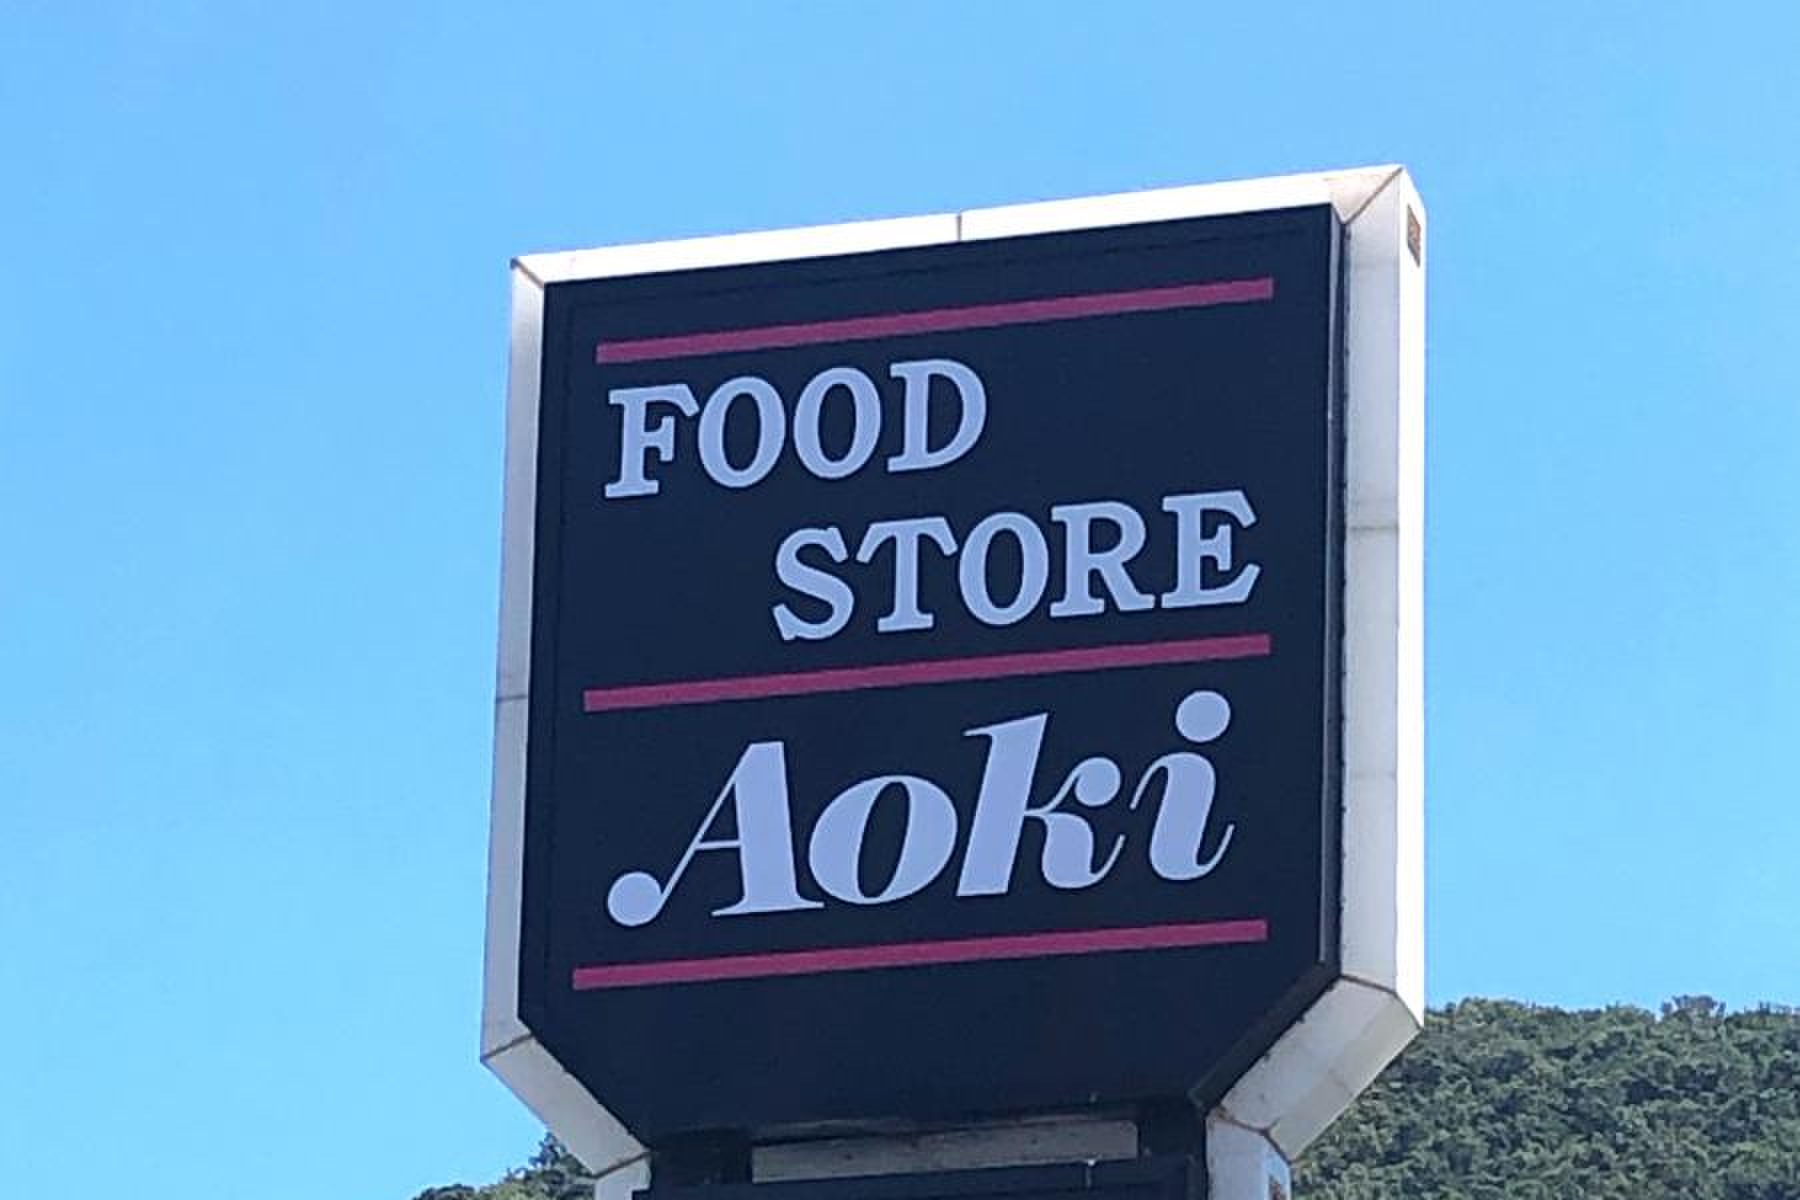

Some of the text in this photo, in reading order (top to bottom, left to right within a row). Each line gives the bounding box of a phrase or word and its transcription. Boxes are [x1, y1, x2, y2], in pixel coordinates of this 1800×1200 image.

[605, 359, 986, 498] FOOD
[772, 490, 1260, 641] STORE
[607, 690, 1234, 926] Aoki
